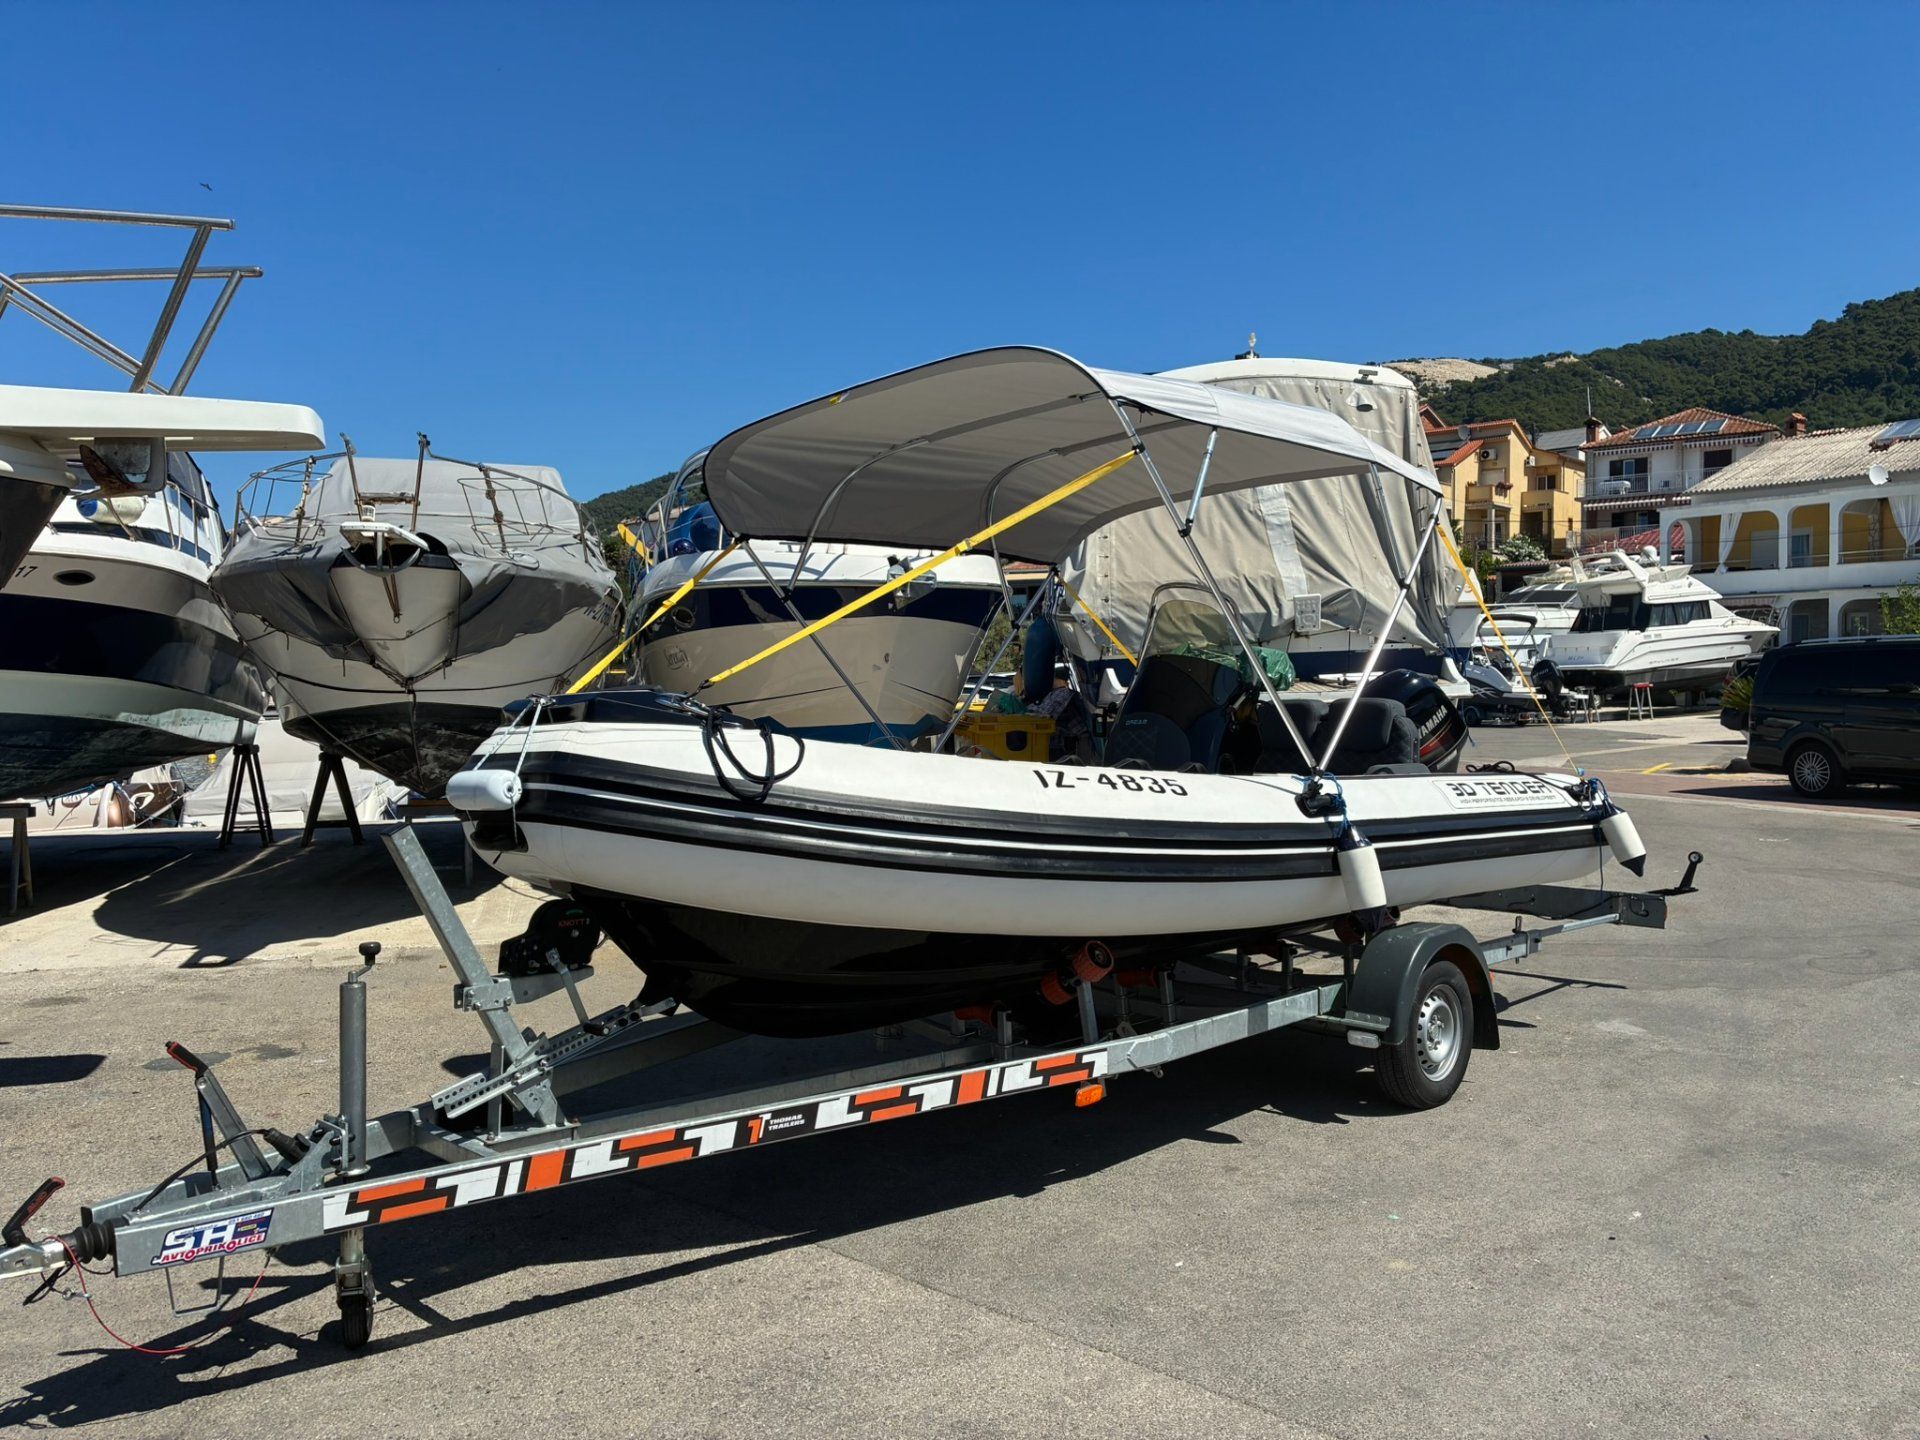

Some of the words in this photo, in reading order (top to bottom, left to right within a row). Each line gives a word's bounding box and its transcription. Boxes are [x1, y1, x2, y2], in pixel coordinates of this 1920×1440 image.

[1033, 769, 1188, 797] IZ-4835
[1446, 782, 1478, 797] 3D
[1476, 780, 1552, 796] TENDER
[768, 1119, 805, 1131] TRAILERS
[769, 1114, 803, 1125] THOMAS
[161, 1233, 265, 1262] AVTOPRIKOLICE
